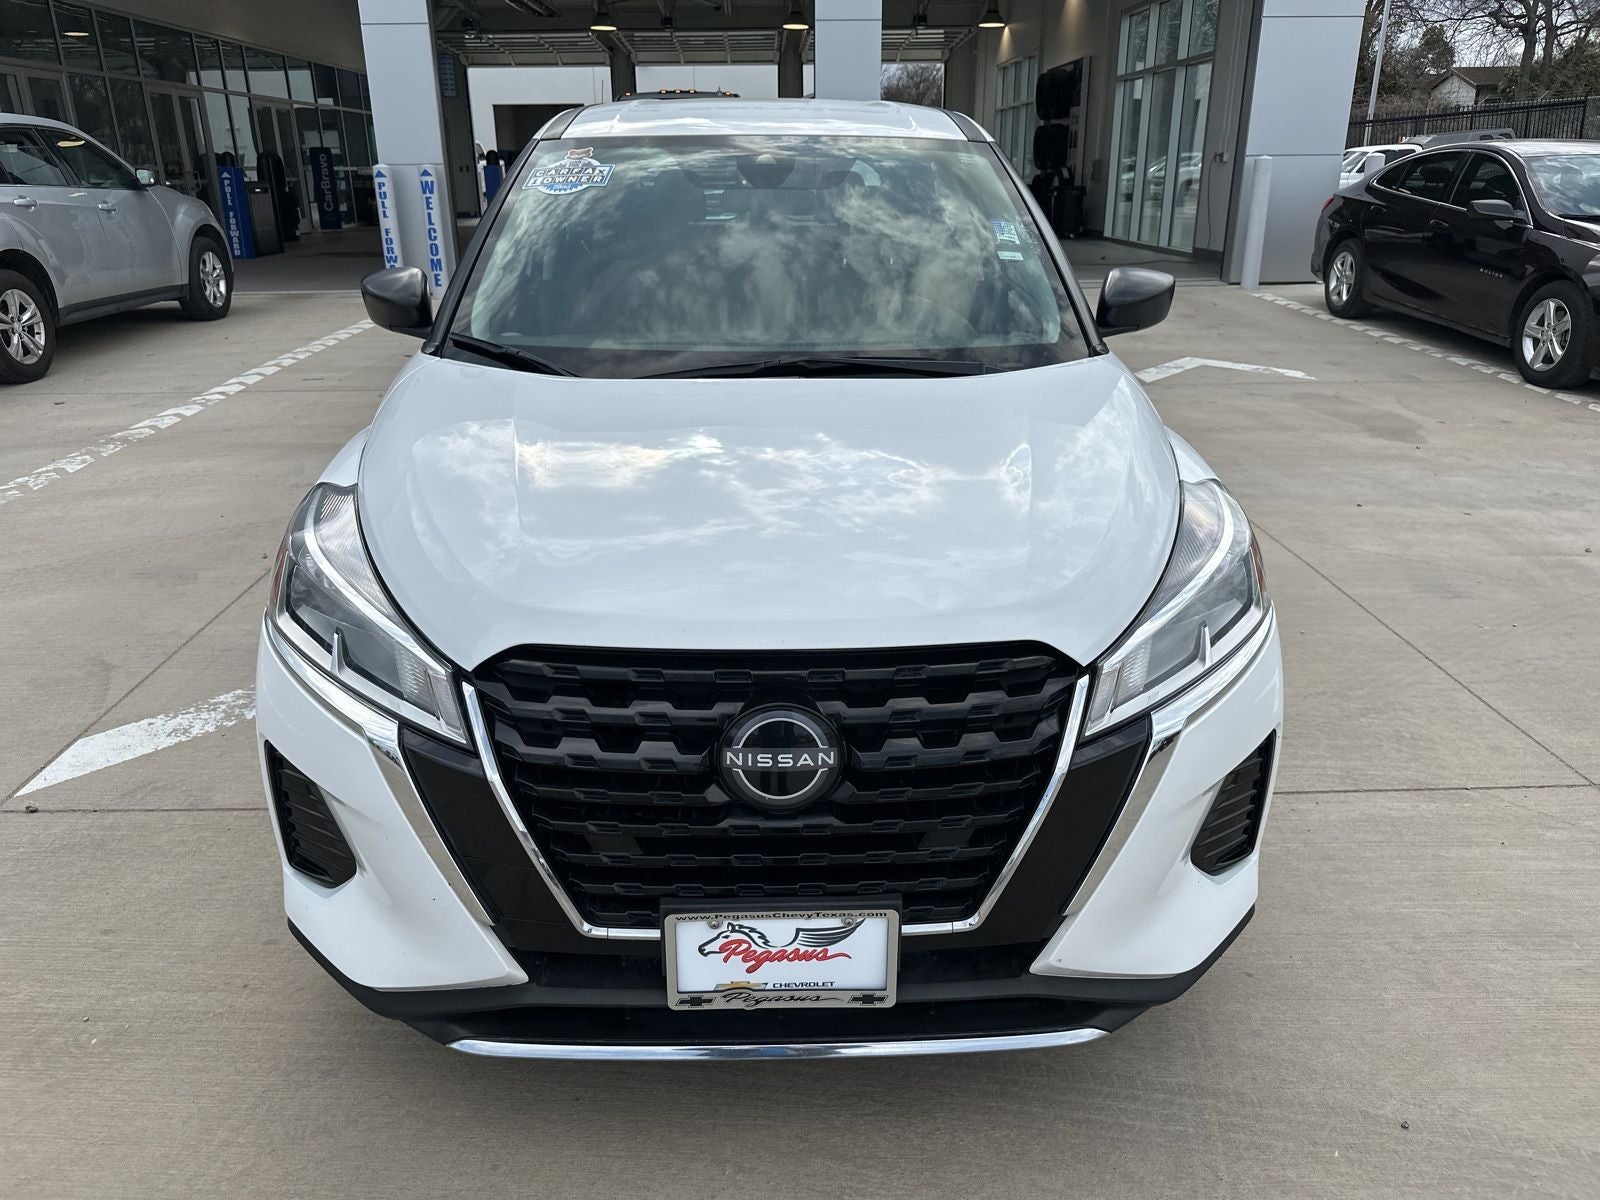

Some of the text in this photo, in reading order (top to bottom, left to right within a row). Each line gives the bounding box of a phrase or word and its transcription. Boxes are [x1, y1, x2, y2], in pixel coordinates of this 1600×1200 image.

[536, 166, 606, 177] CARFAX
[320, 153, 334, 211] CarBravo
[543, 176, 603, 185] OWNER
[224, 179, 233, 206] PULL
[377, 181, 389, 219] PULL
[420, 180, 442, 287] WELCOME
[726, 751, 834, 767] NISSAN
[675, 911, 888, 921] www.PegasusChevyTexas.com
[719, 938, 852, 974] Pegasus
[772, 981, 836, 989] CHEVROLET
[721, 991, 843, 1008] Pegasus
